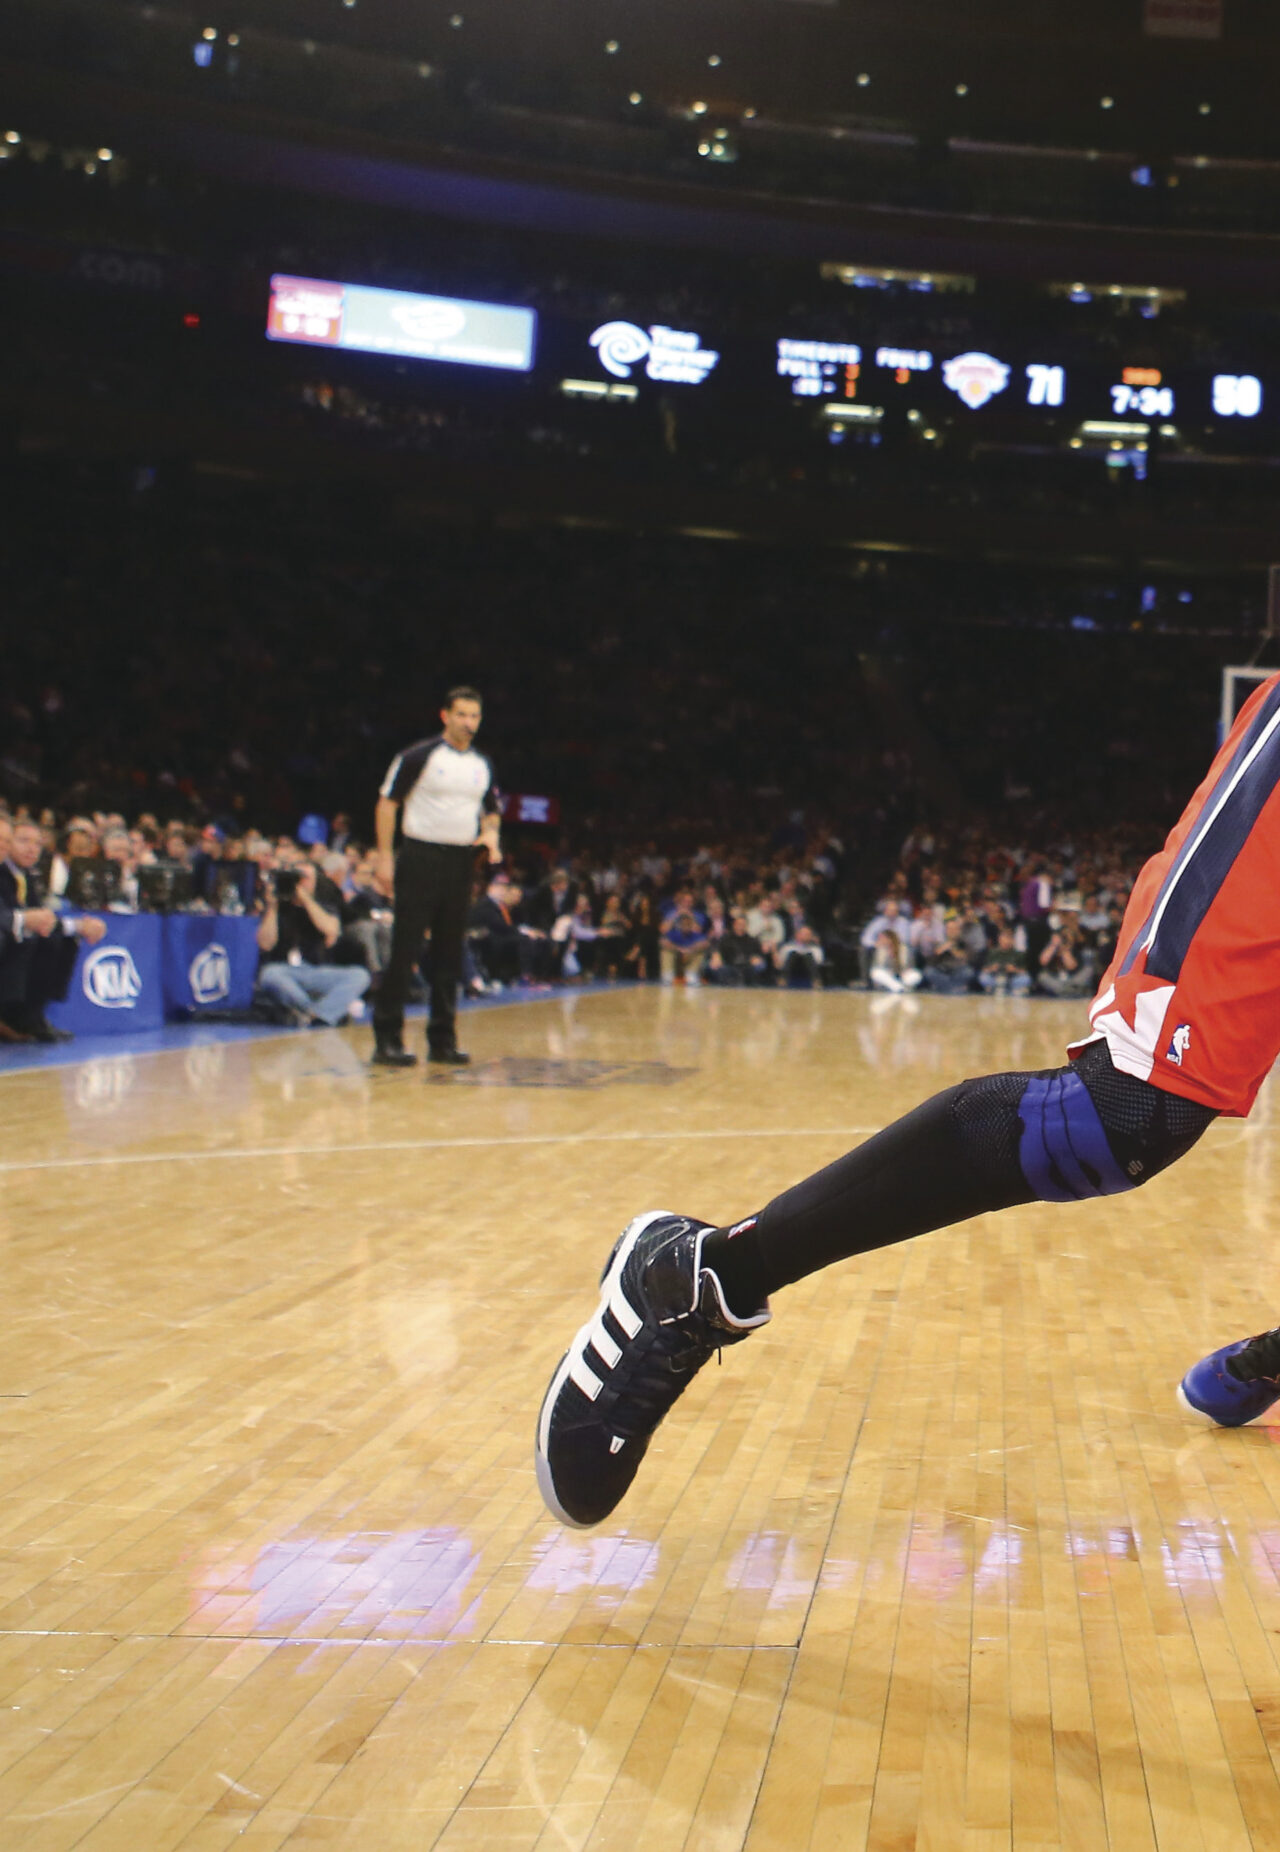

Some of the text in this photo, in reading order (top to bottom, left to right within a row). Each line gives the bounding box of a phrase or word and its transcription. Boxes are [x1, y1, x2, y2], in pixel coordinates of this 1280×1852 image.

[777, 338, 861, 364] TIMEOUTS
[876, 347, 932, 371] FOULS
[1026, 364, 1064, 406] 71
